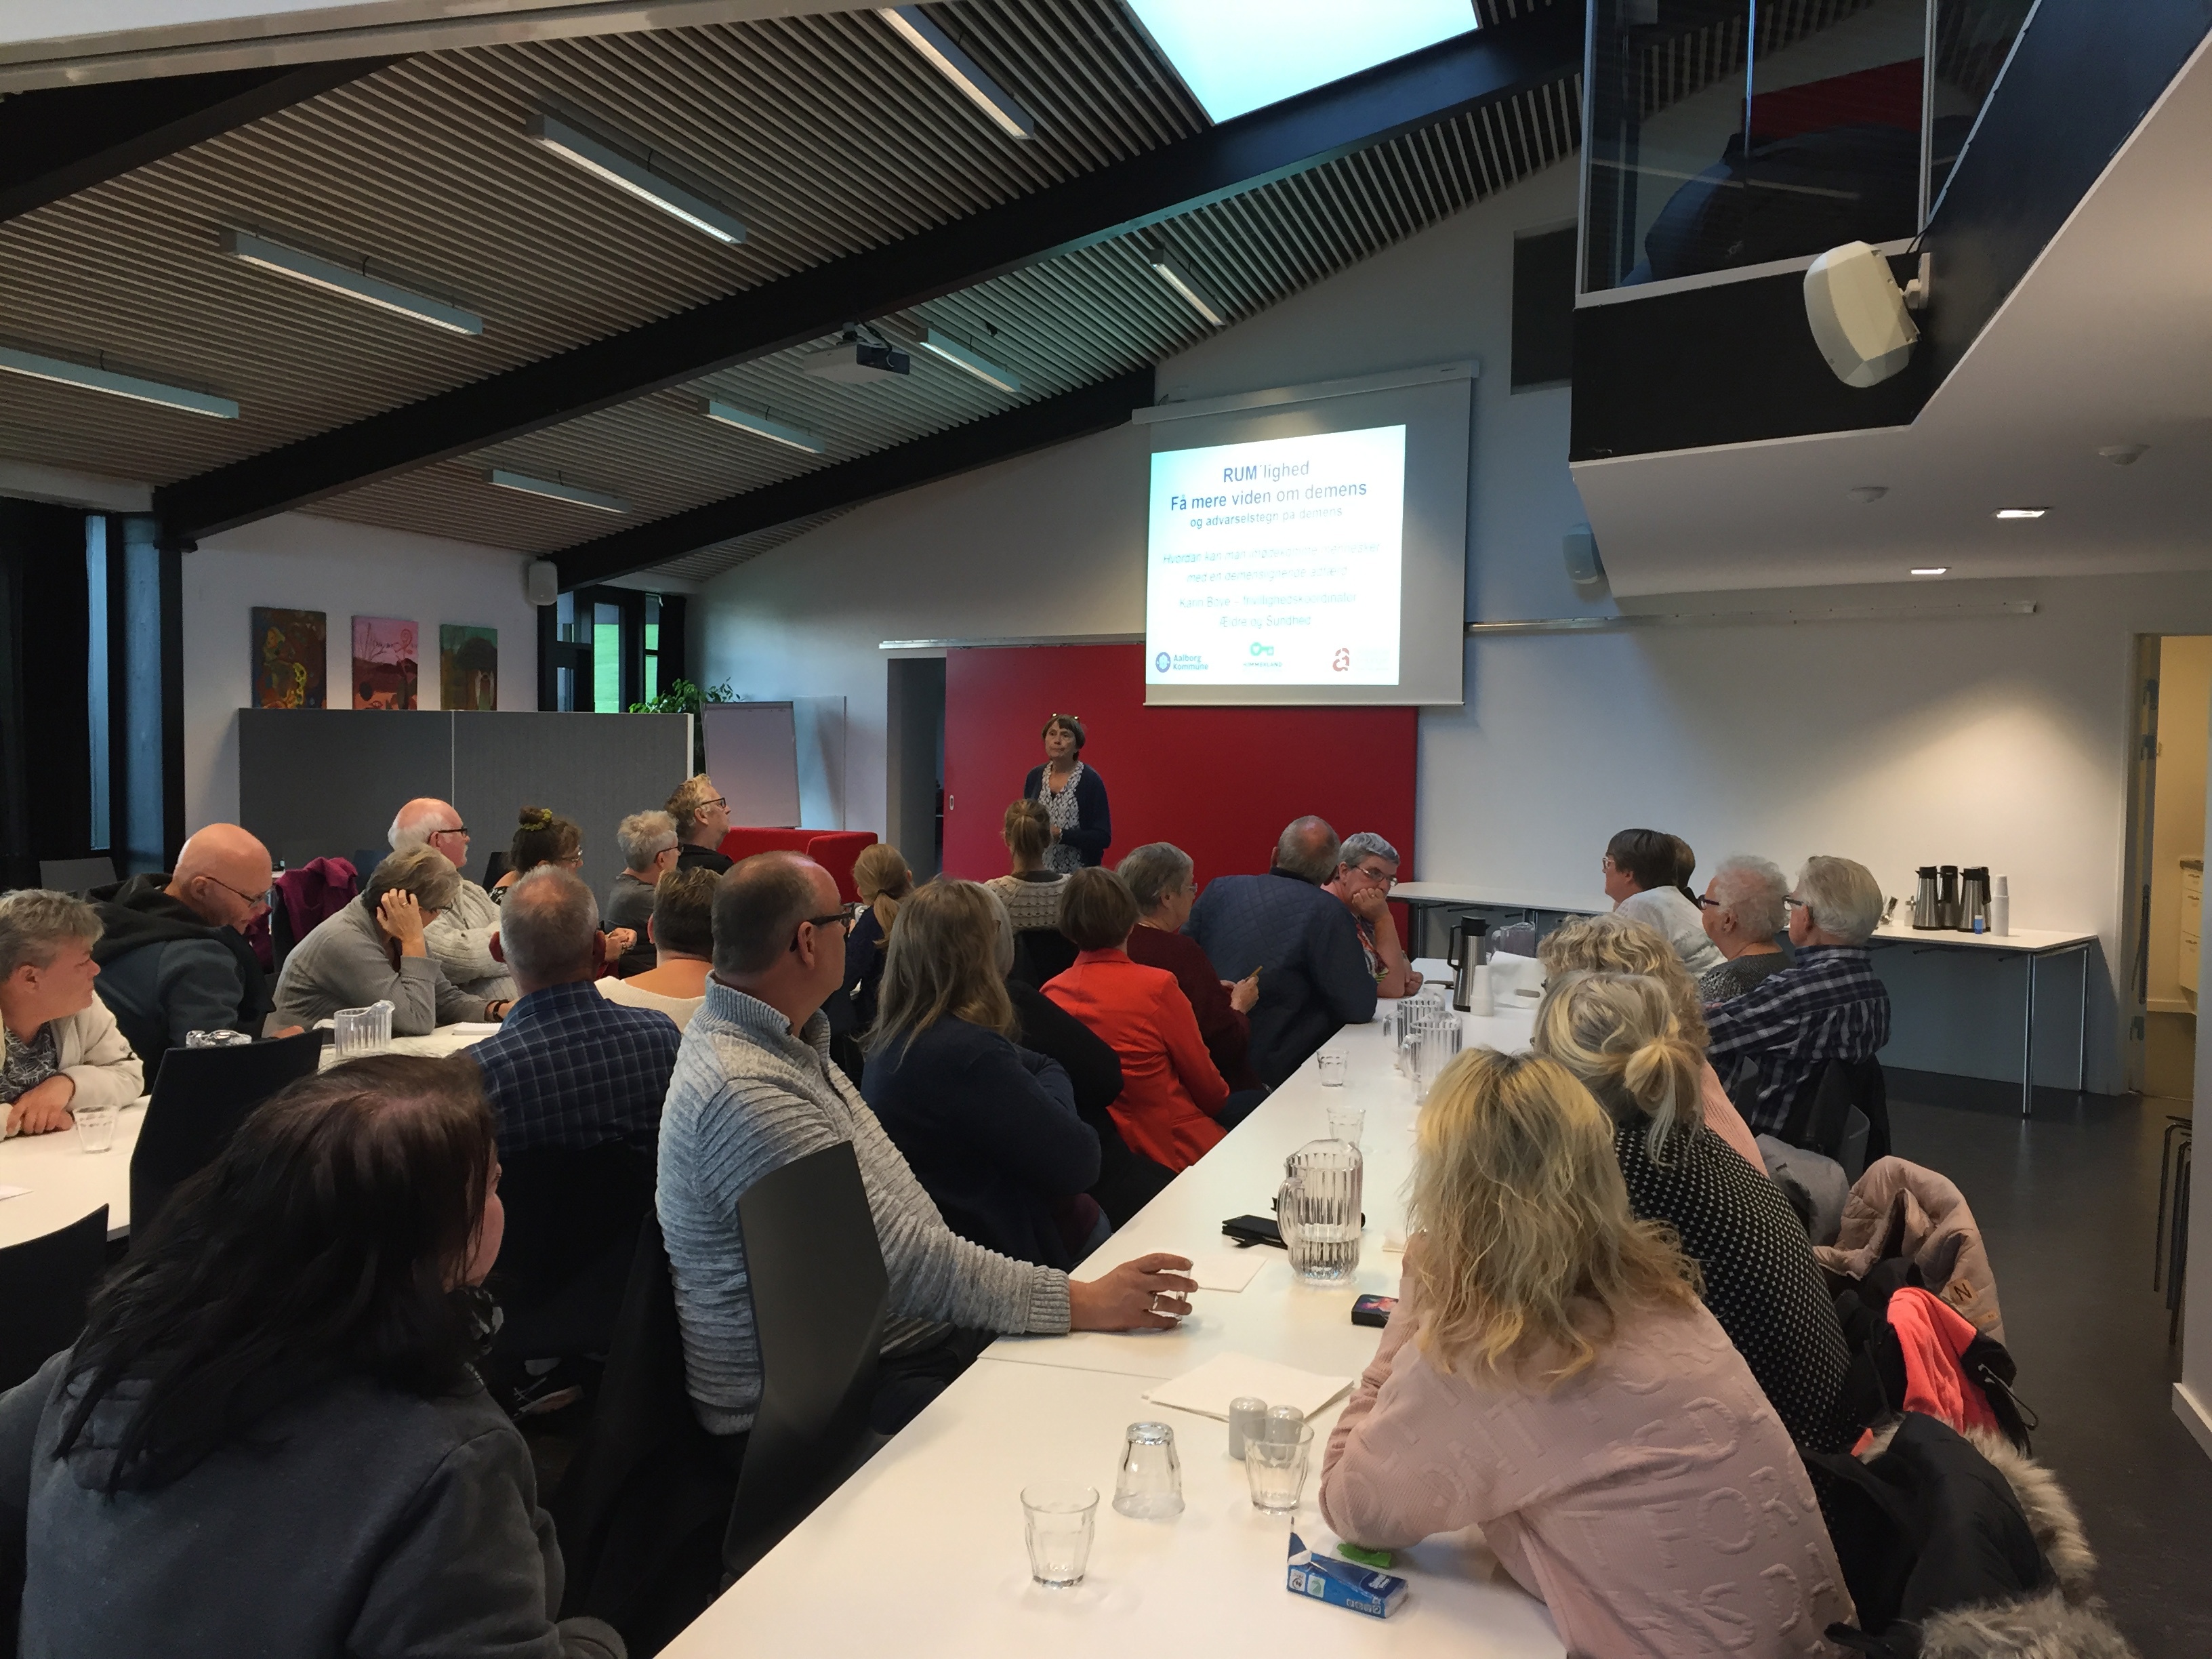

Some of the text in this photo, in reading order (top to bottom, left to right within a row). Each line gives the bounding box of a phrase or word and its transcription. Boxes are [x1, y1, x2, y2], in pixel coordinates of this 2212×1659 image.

[1171, 483, 1367, 511] Få mere viden om demens
[1190, 518, 1203, 529] og
[1206, 512, 1279, 527] advarselstegn
[1299, 508, 1343, 519] demens
[1173, 654, 1202, 663] Aalborg
[1173, 663, 1209, 671] Kommune
